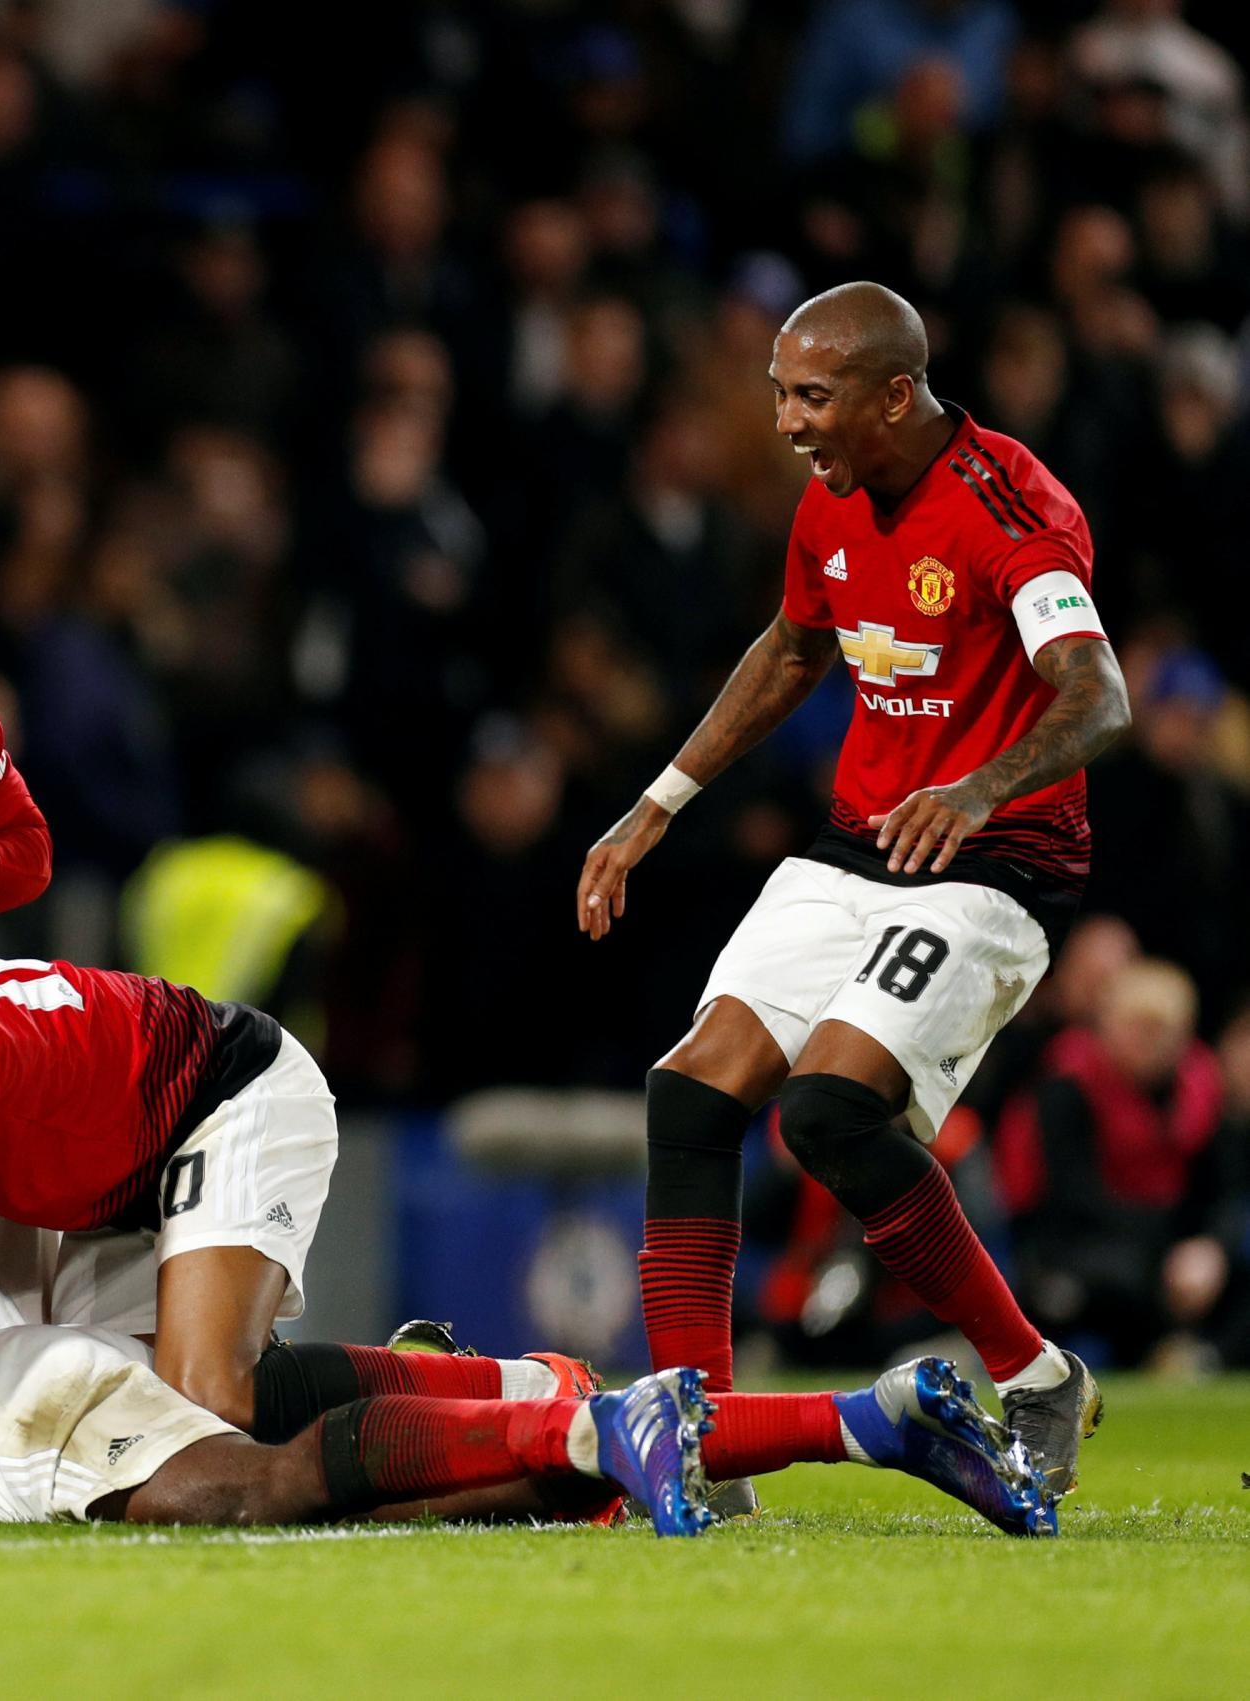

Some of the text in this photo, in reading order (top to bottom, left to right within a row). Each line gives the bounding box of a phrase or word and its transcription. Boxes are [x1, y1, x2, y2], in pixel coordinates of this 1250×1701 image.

[823, 565, 848, 581] adidas
[913, 560, 952, 584] MANCHESTER
[917, 600, 945, 613] UNITED
[1056, 595, 1090, 610] RES
[858, 689, 954, 718] VROLET
[854, 925, 950, 1003] 18
[162, 1149, 207, 1221] 0
[109, 1434, 144, 1466] adidas
